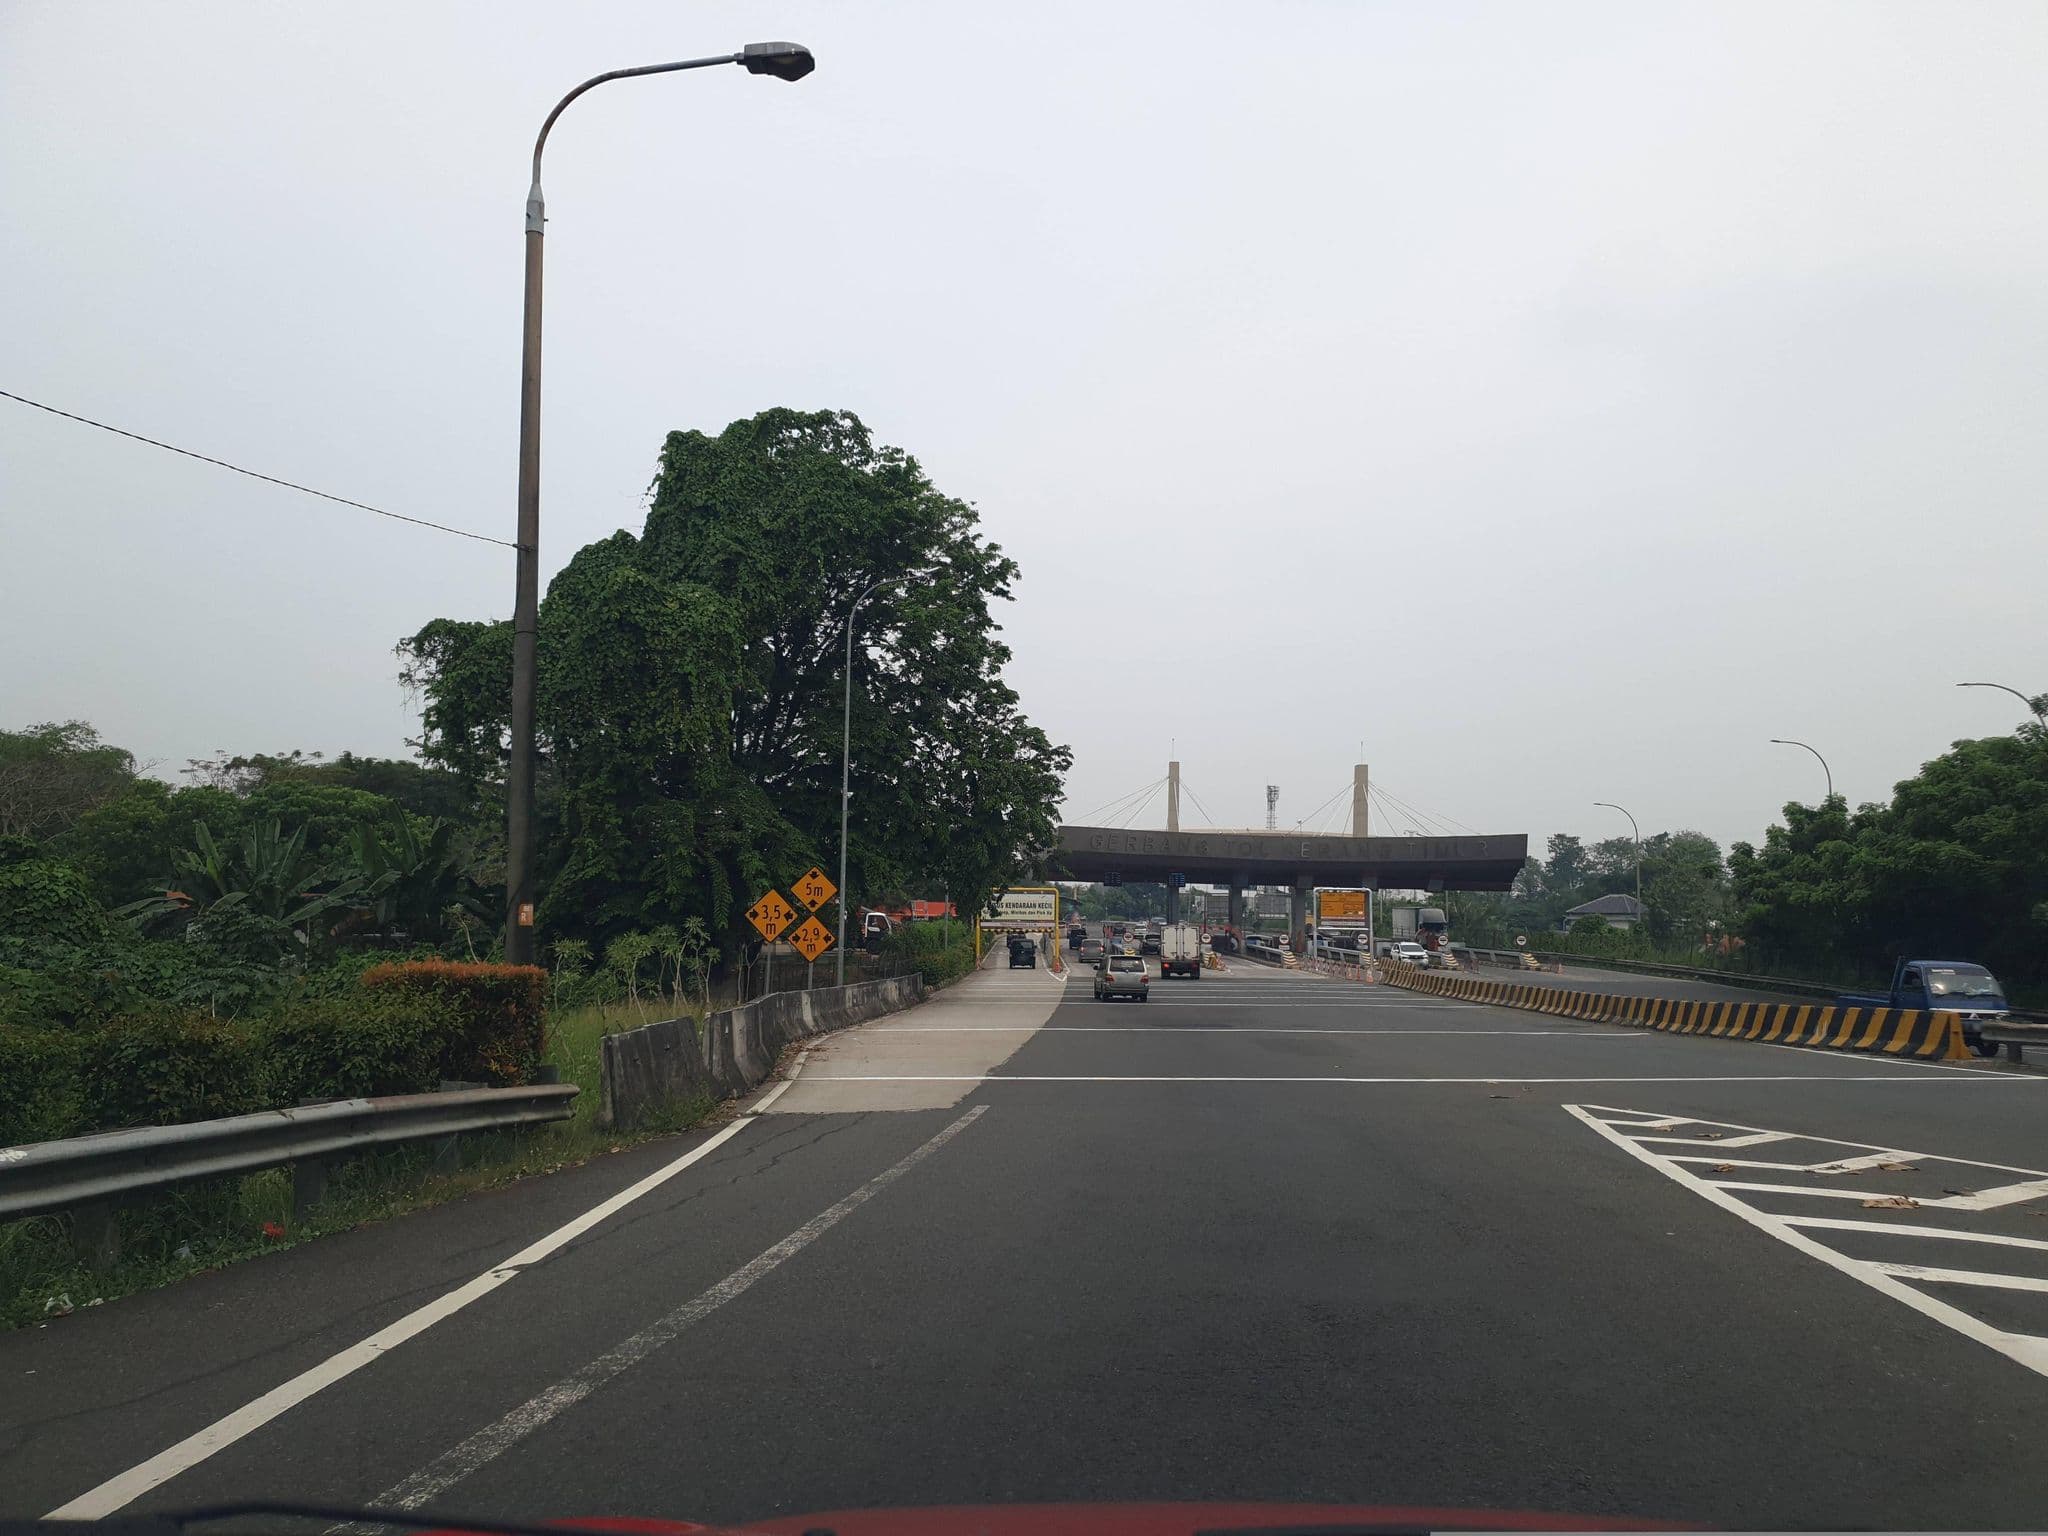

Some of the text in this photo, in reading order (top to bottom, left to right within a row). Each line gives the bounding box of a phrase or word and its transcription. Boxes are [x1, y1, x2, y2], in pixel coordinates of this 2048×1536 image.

[1089, 834, 1209, 856] GERBANG
[1225, 840, 1269, 859] TOL
[762, 904, 780, 922] 3,5
[766, 922, 776, 935] m
[802, 927, 820, 943] 2,9
[807, 943, 816, 952] m
